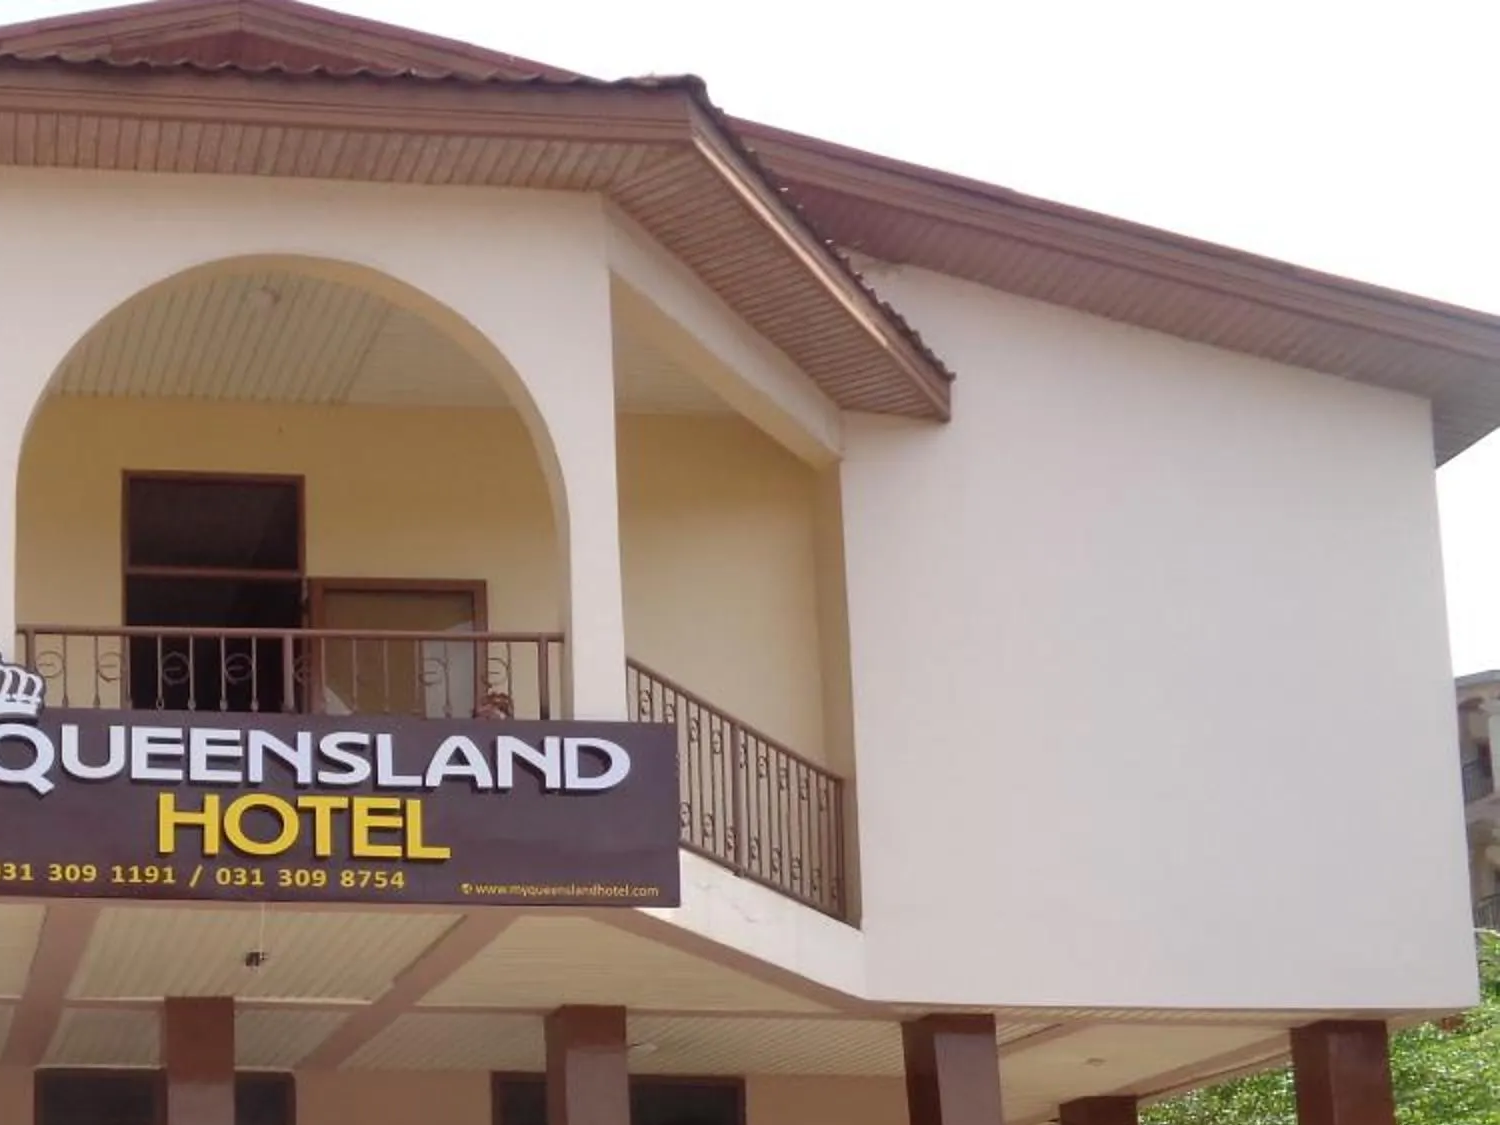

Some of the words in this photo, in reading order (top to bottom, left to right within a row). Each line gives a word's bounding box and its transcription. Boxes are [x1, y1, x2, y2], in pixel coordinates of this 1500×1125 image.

[158, 792, 452, 861] HOTEL
[48, 863, 98, 882] 309
[111, 864, 176, 884] 1191
[215, 867, 264, 886] 031
[277, 868, 327, 888] 309
[340, 869, 405, 889] 8754
[475, 883, 659, 897] www.myqueenslandhotel.com
